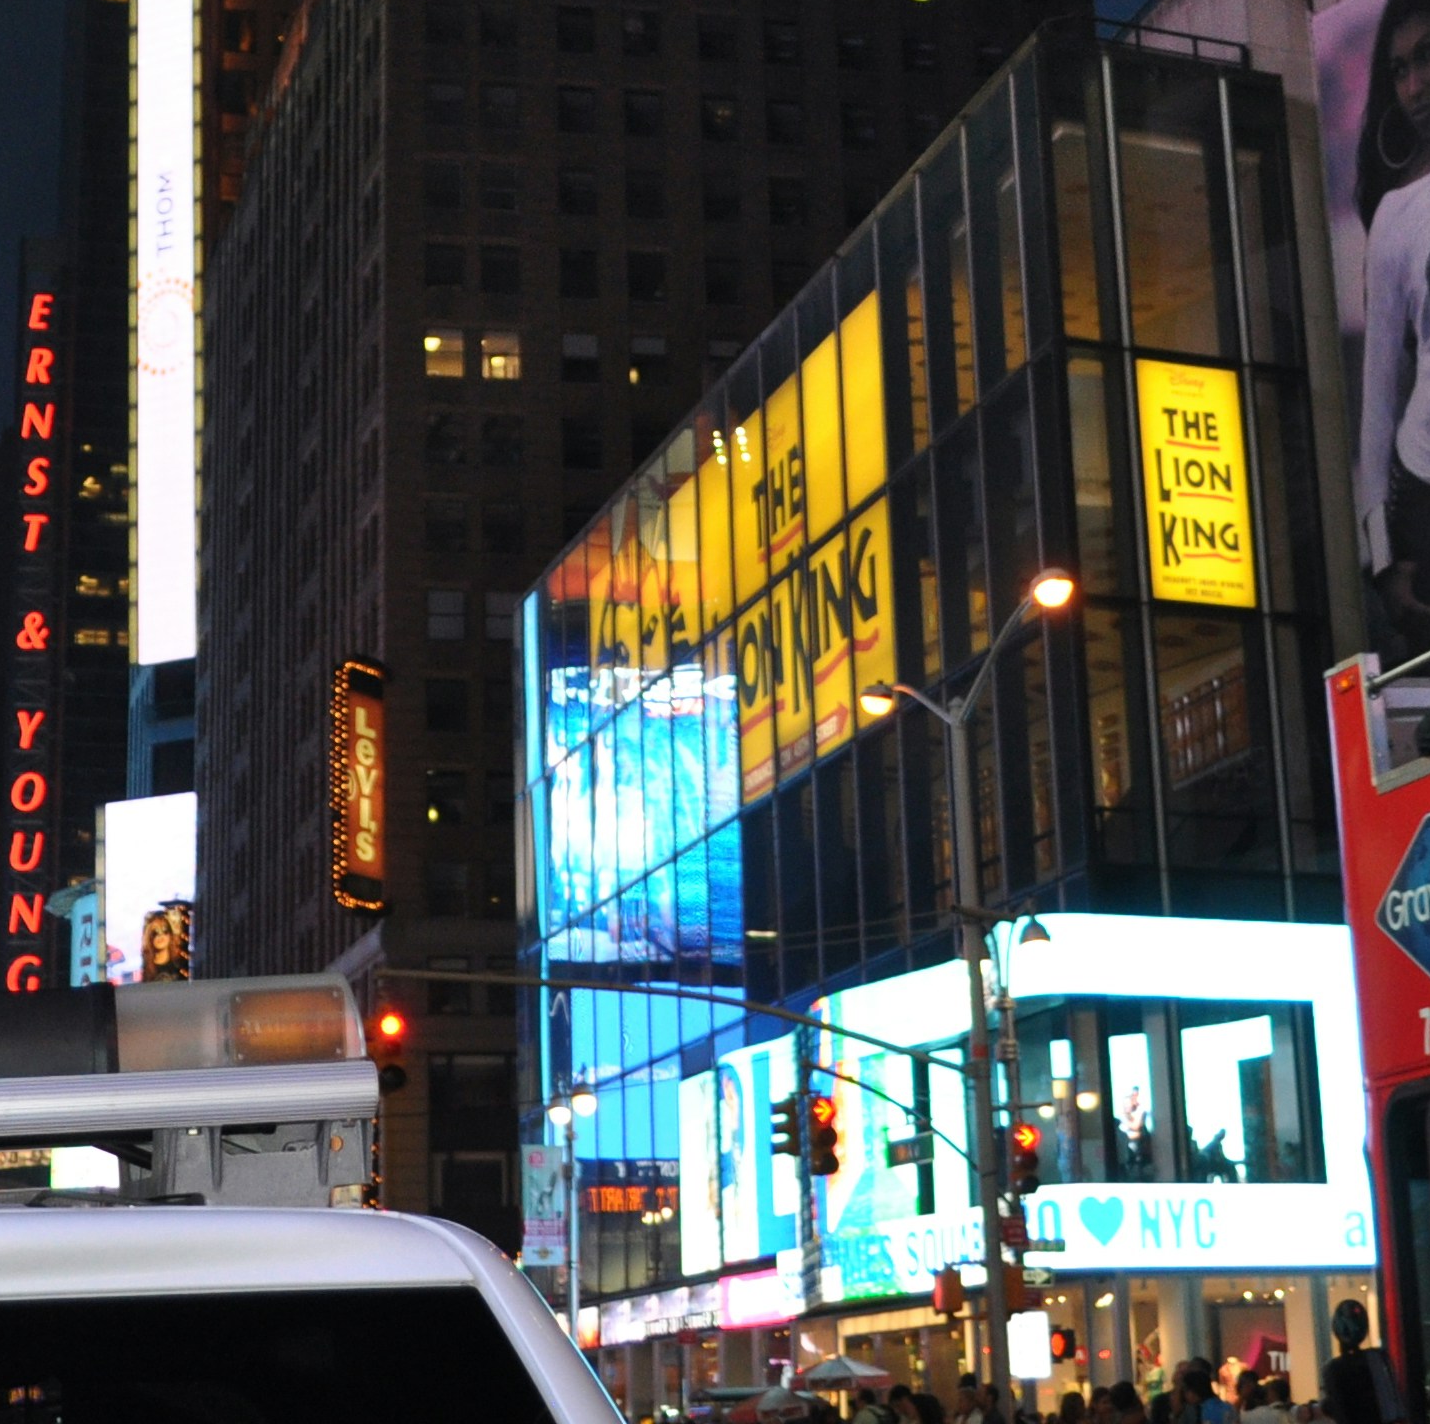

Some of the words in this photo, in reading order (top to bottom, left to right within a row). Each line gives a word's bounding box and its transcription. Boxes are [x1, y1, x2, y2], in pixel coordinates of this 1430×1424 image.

[20, 292, 55, 553] ERNST
[1162, 408, 1219, 442] THE
[752, 443, 804, 549] THE
[1154, 448, 1233, 503] LION
[1158, 511, 1241, 567] KING
[16, 610, 49, 652] &
[5, 708, 46, 993] YOUNG
[1138, 1197, 1217, 1250] NYC
